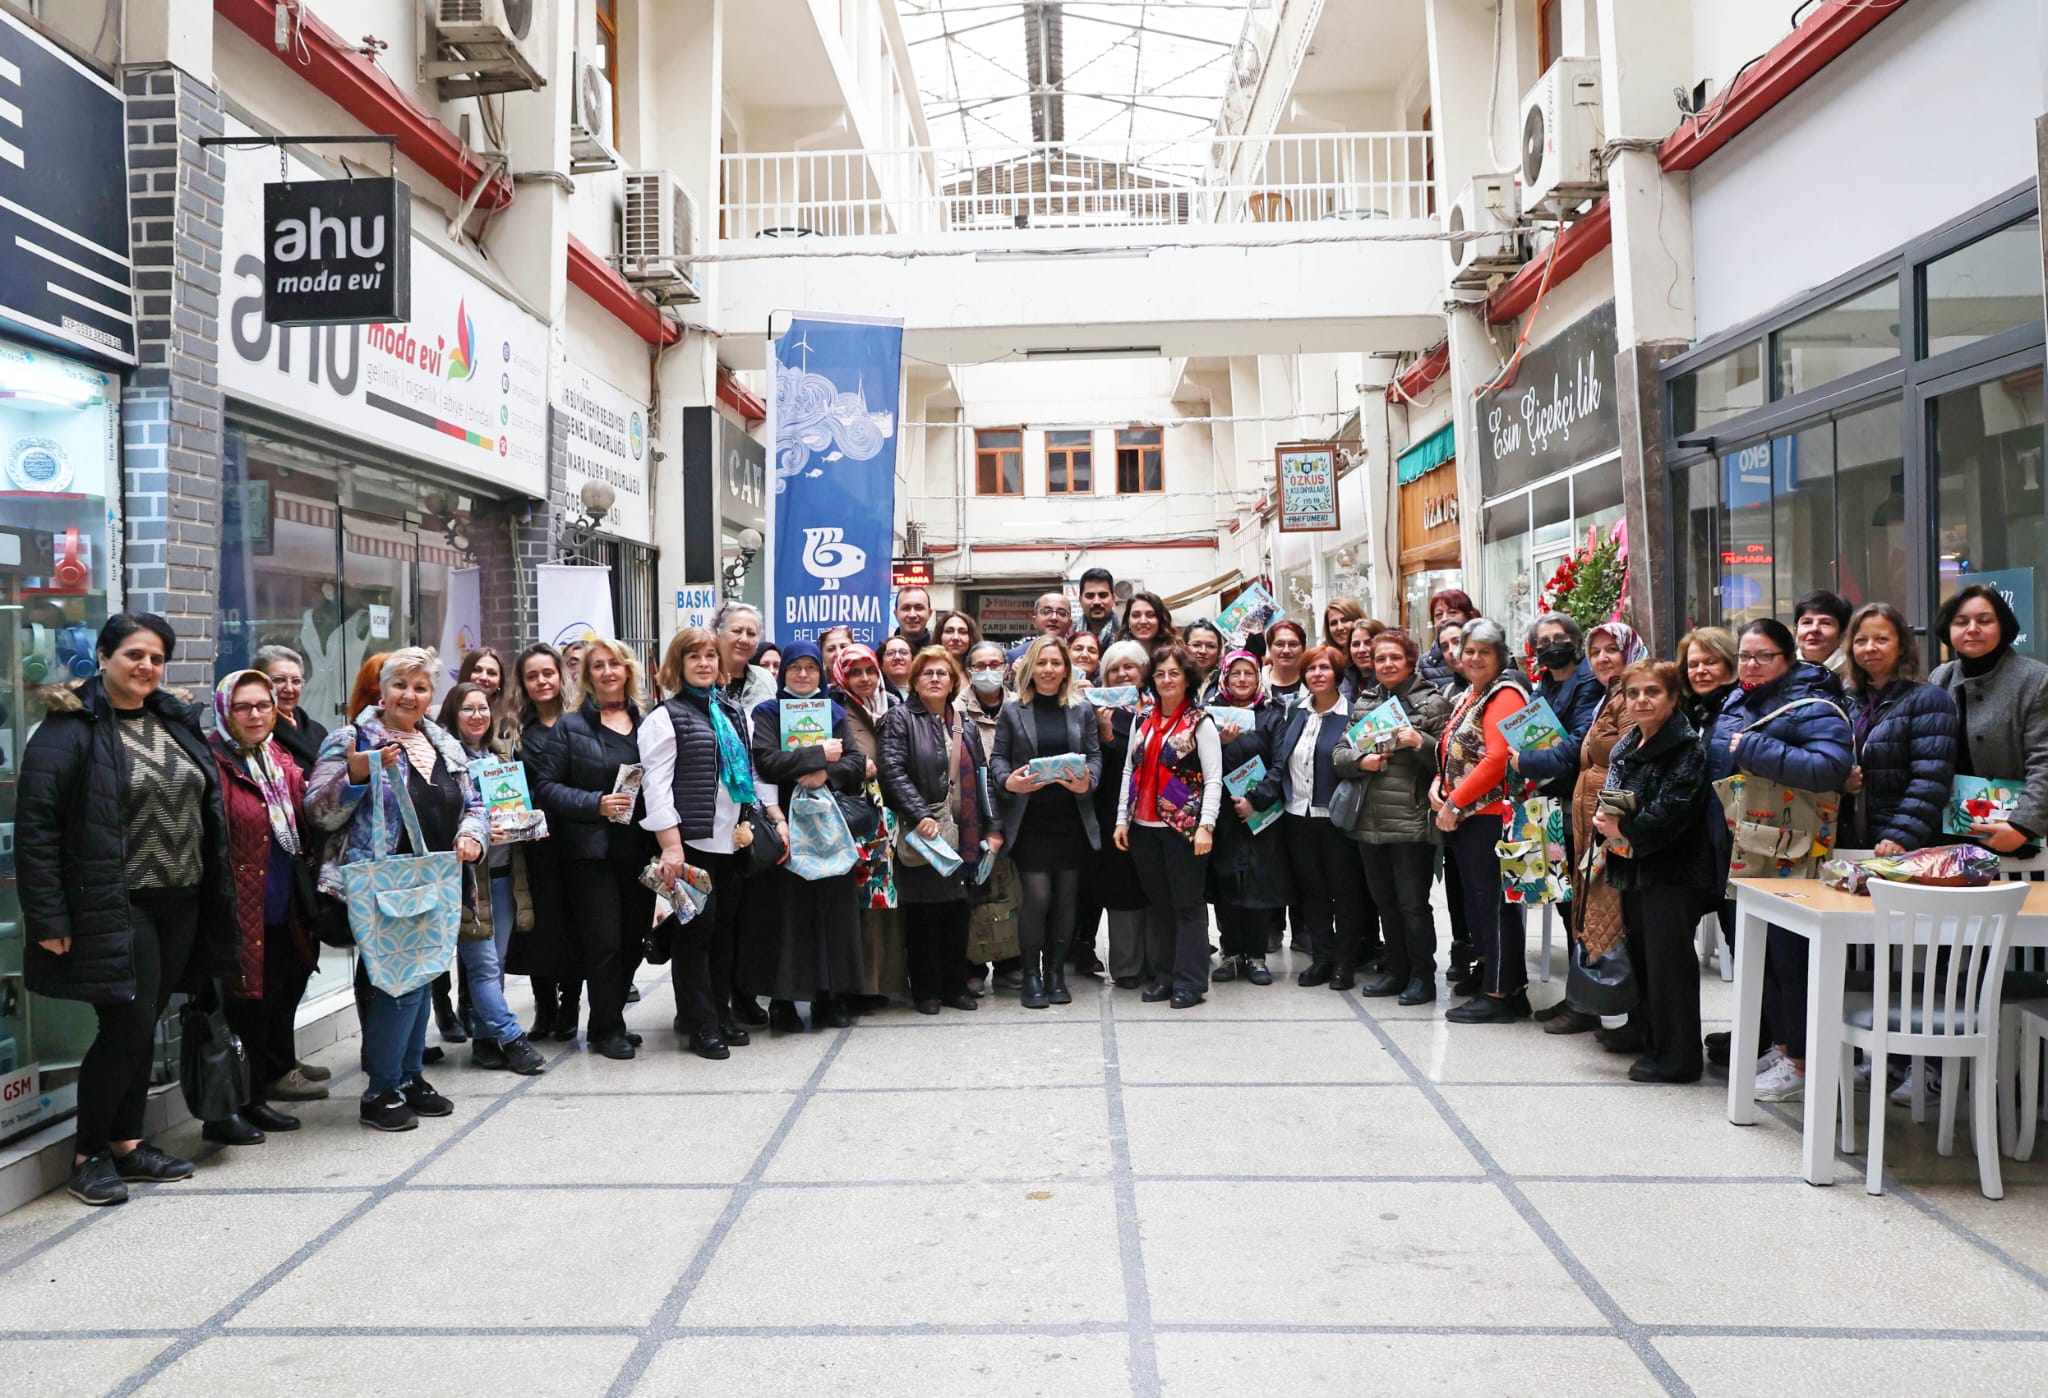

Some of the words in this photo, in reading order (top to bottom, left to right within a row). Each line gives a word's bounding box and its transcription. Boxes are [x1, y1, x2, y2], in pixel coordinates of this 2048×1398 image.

[274, 206, 384, 261] ahu
[277, 269, 342, 293] moda
[348, 262, 385, 290] evi
[367, 322, 416, 365] moda
[419, 335, 445, 377] evi
[589, 423, 626, 458] MÜDÜRLÜĞÜ
[1489, 407, 1521, 459] Esin
[605, 466, 640, 496] MÜDÜRLÜĞÜ
[728, 449, 766, 512] CAV
[896, 575, 930, 584] NUMARA
[690, 614, 704, 628] SU
[785, 594, 881, 624] BANDIRMA
[794, 626, 874, 643] BELESİ
[786, 701, 809, 710] Enerjik
[1504, 713, 1526, 730] Enerjik
[483, 767, 504, 777] Enerjik
[4, 1076, 31, 1102] GSM
